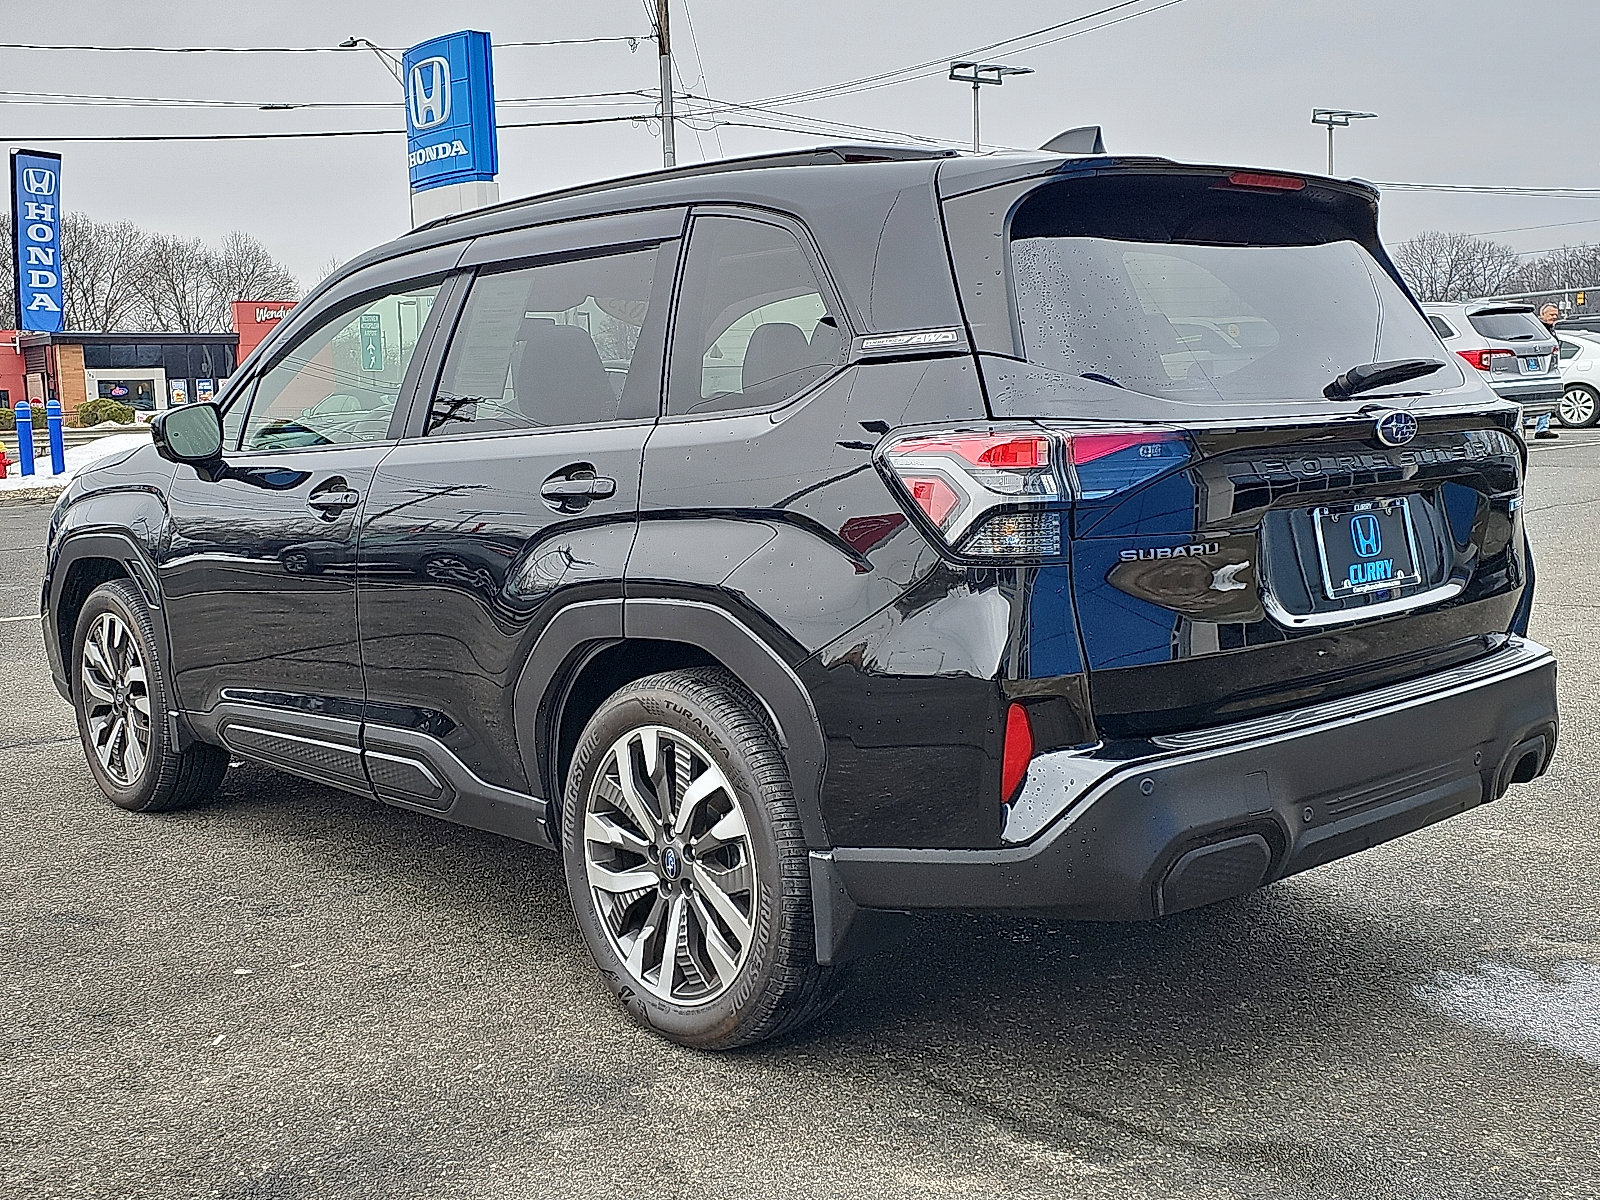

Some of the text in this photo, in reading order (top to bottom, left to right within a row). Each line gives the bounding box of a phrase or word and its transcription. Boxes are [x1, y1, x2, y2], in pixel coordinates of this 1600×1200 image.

[408, 140, 469, 168] HONDA
[24, 202, 60, 312] HONDA
[1264, 441, 1487, 477] FORESTER
[1120, 542, 1219, 562] SUBARU
[1349, 559, 1394, 585] CURRY
[664, 700, 730, 759] TURANZA
